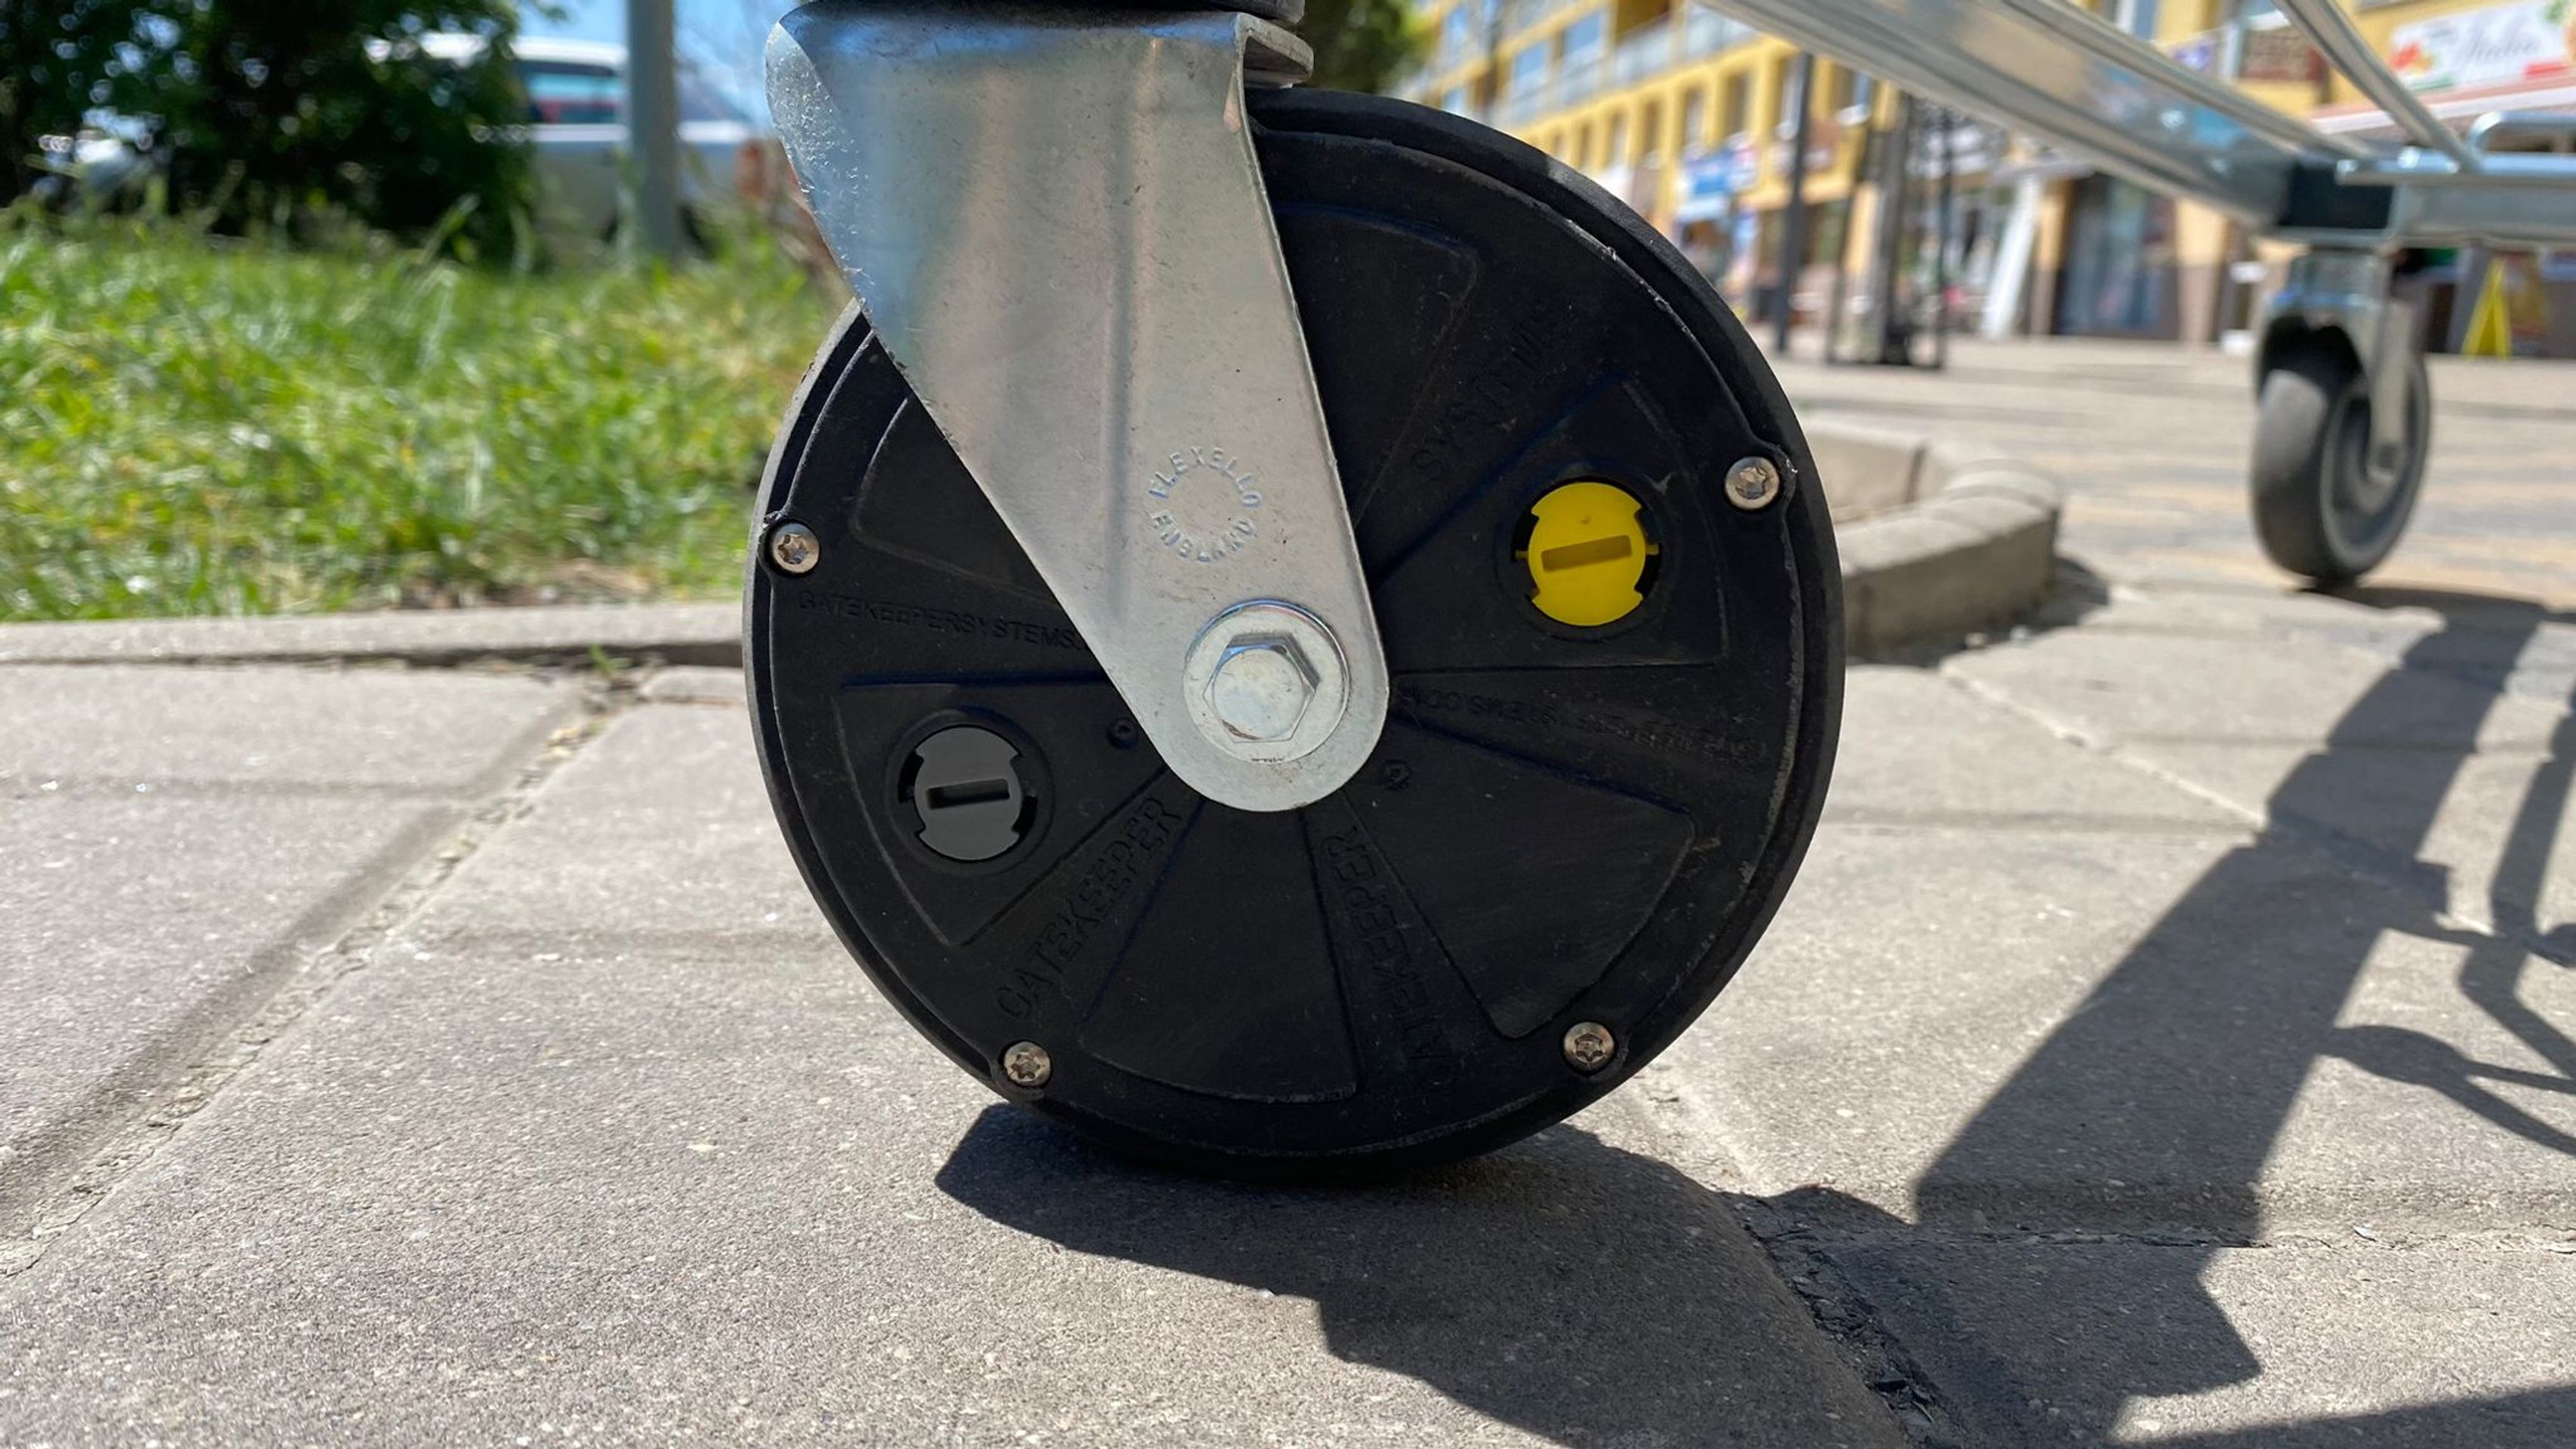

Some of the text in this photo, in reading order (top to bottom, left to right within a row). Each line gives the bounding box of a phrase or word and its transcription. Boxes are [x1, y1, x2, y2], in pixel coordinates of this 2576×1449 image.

[1148, 445, 1263, 509] FLEXELLO
[1150, 510, 1259, 564] ENGLAND
[996, 796, 1183, 1020] GATEKEEPER
